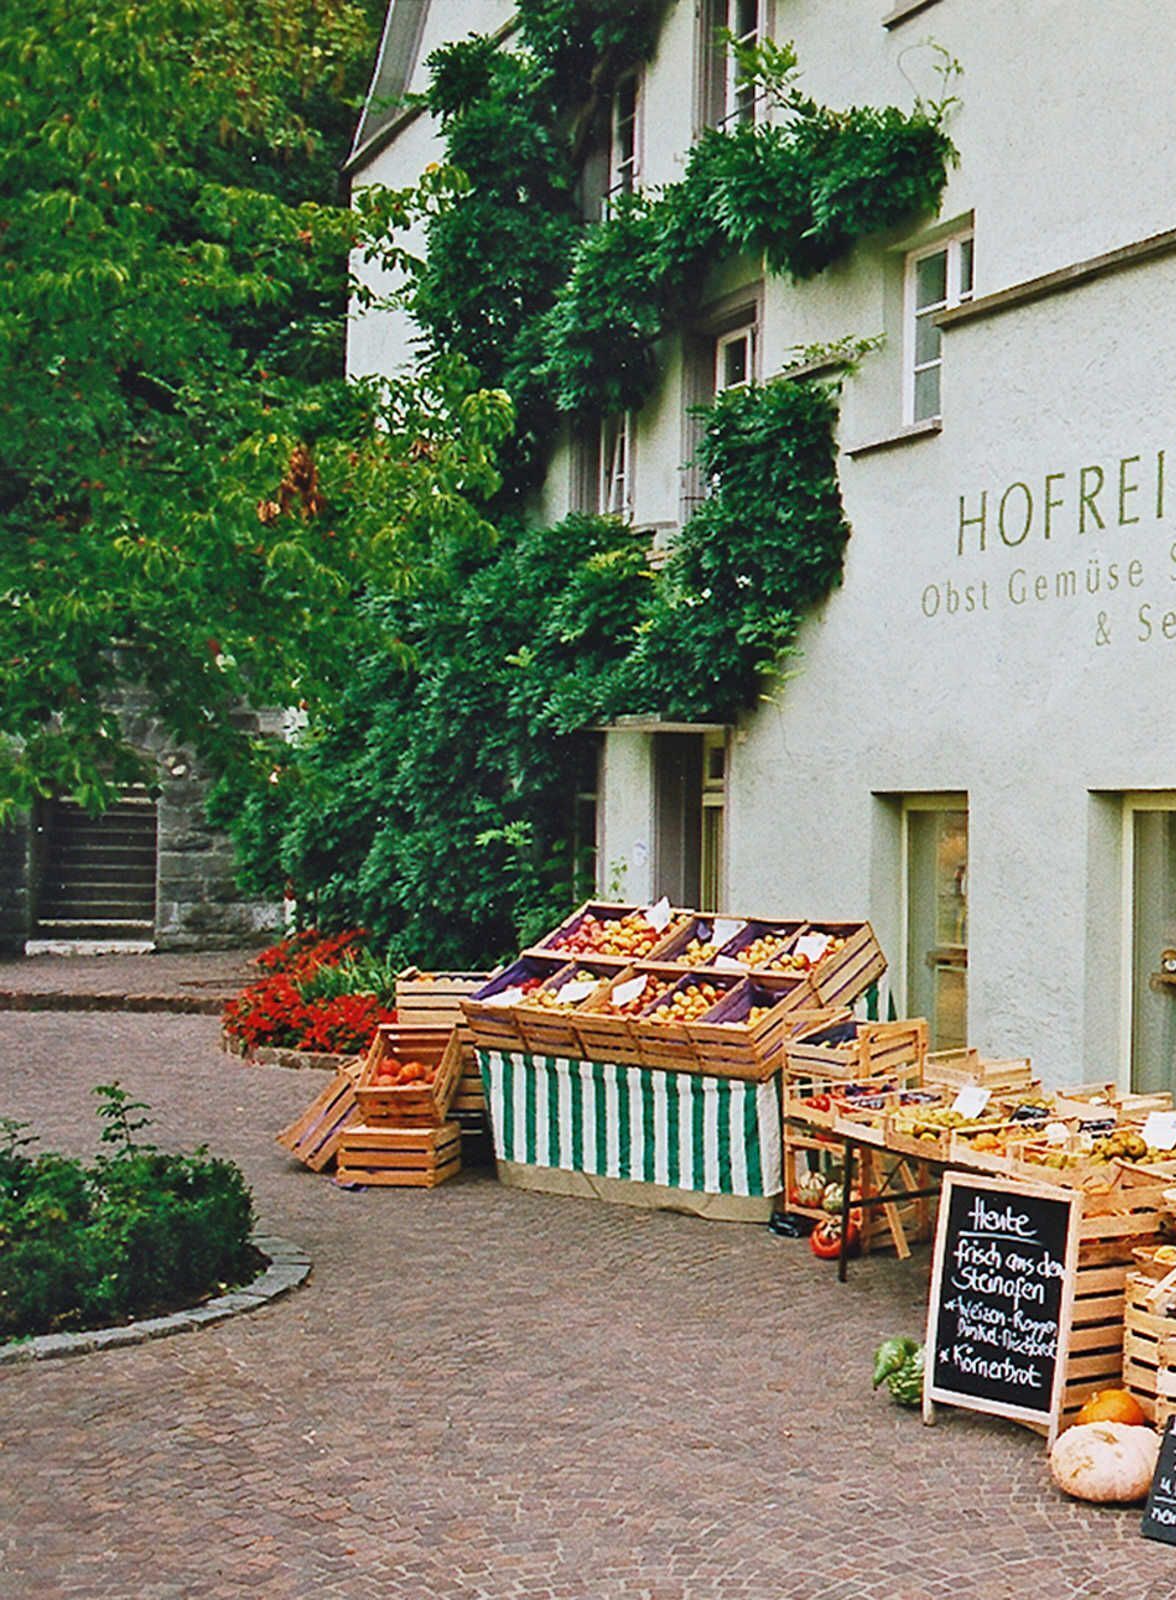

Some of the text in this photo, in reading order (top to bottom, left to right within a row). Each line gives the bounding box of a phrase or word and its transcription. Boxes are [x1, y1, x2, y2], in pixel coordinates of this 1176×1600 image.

[921, 579, 990, 618] Obst
[1008, 557, 1144, 605] Gemüse
[1095, 610, 1112, 647] &
[968, 1196, 1038, 1236] Heute
[953, 1239, 1002, 1269] frisch
[1005, 1253, 1035, 1276] aus
[951, 1265, 1045, 1311] Steinofen
[953, 1343, 1043, 1387] Körnerbrot
